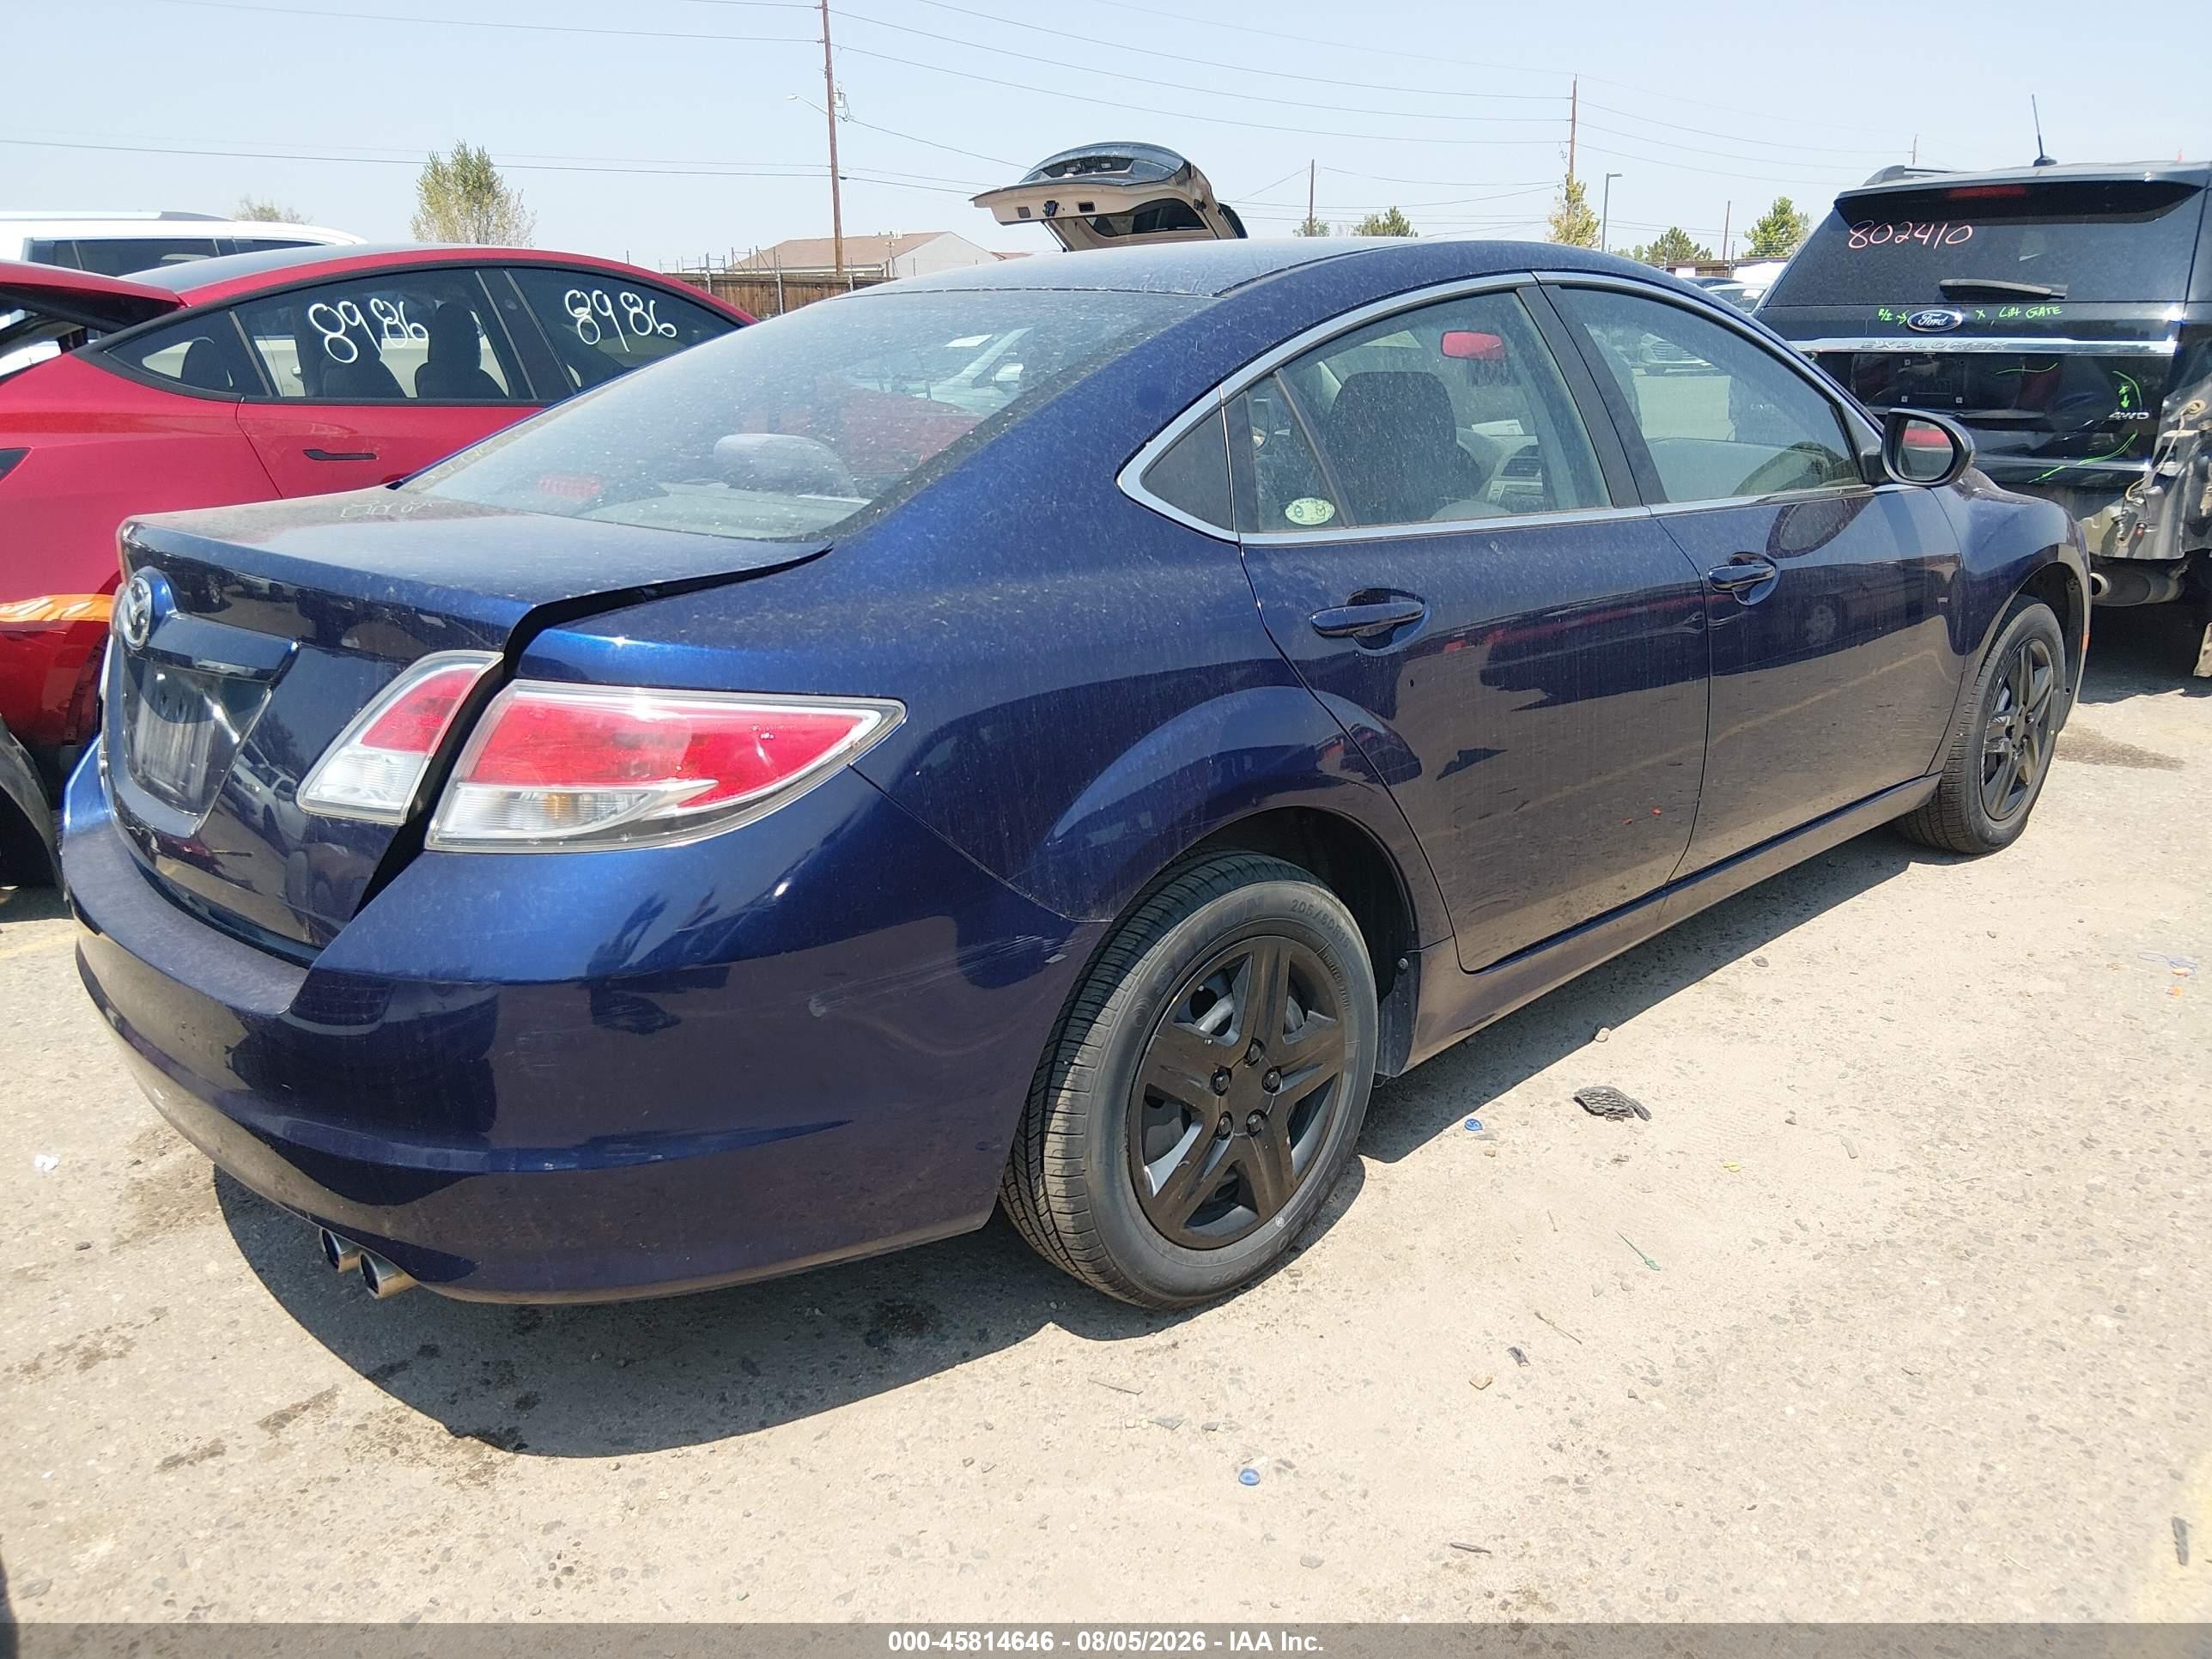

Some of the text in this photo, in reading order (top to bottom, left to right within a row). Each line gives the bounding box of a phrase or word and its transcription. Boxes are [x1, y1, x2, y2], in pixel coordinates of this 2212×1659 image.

[1848, 219, 1973, 249] 802410
[2026, 306, 2063, 319] GATE
[563, 289, 678, 353] 8986
[1917, 313, 1948, 326] Ford
[307, 296, 429, 364] 8986
[1861, 340, 2008, 351] EXPLORER
[2108, 411, 2149, 420] 4WD
